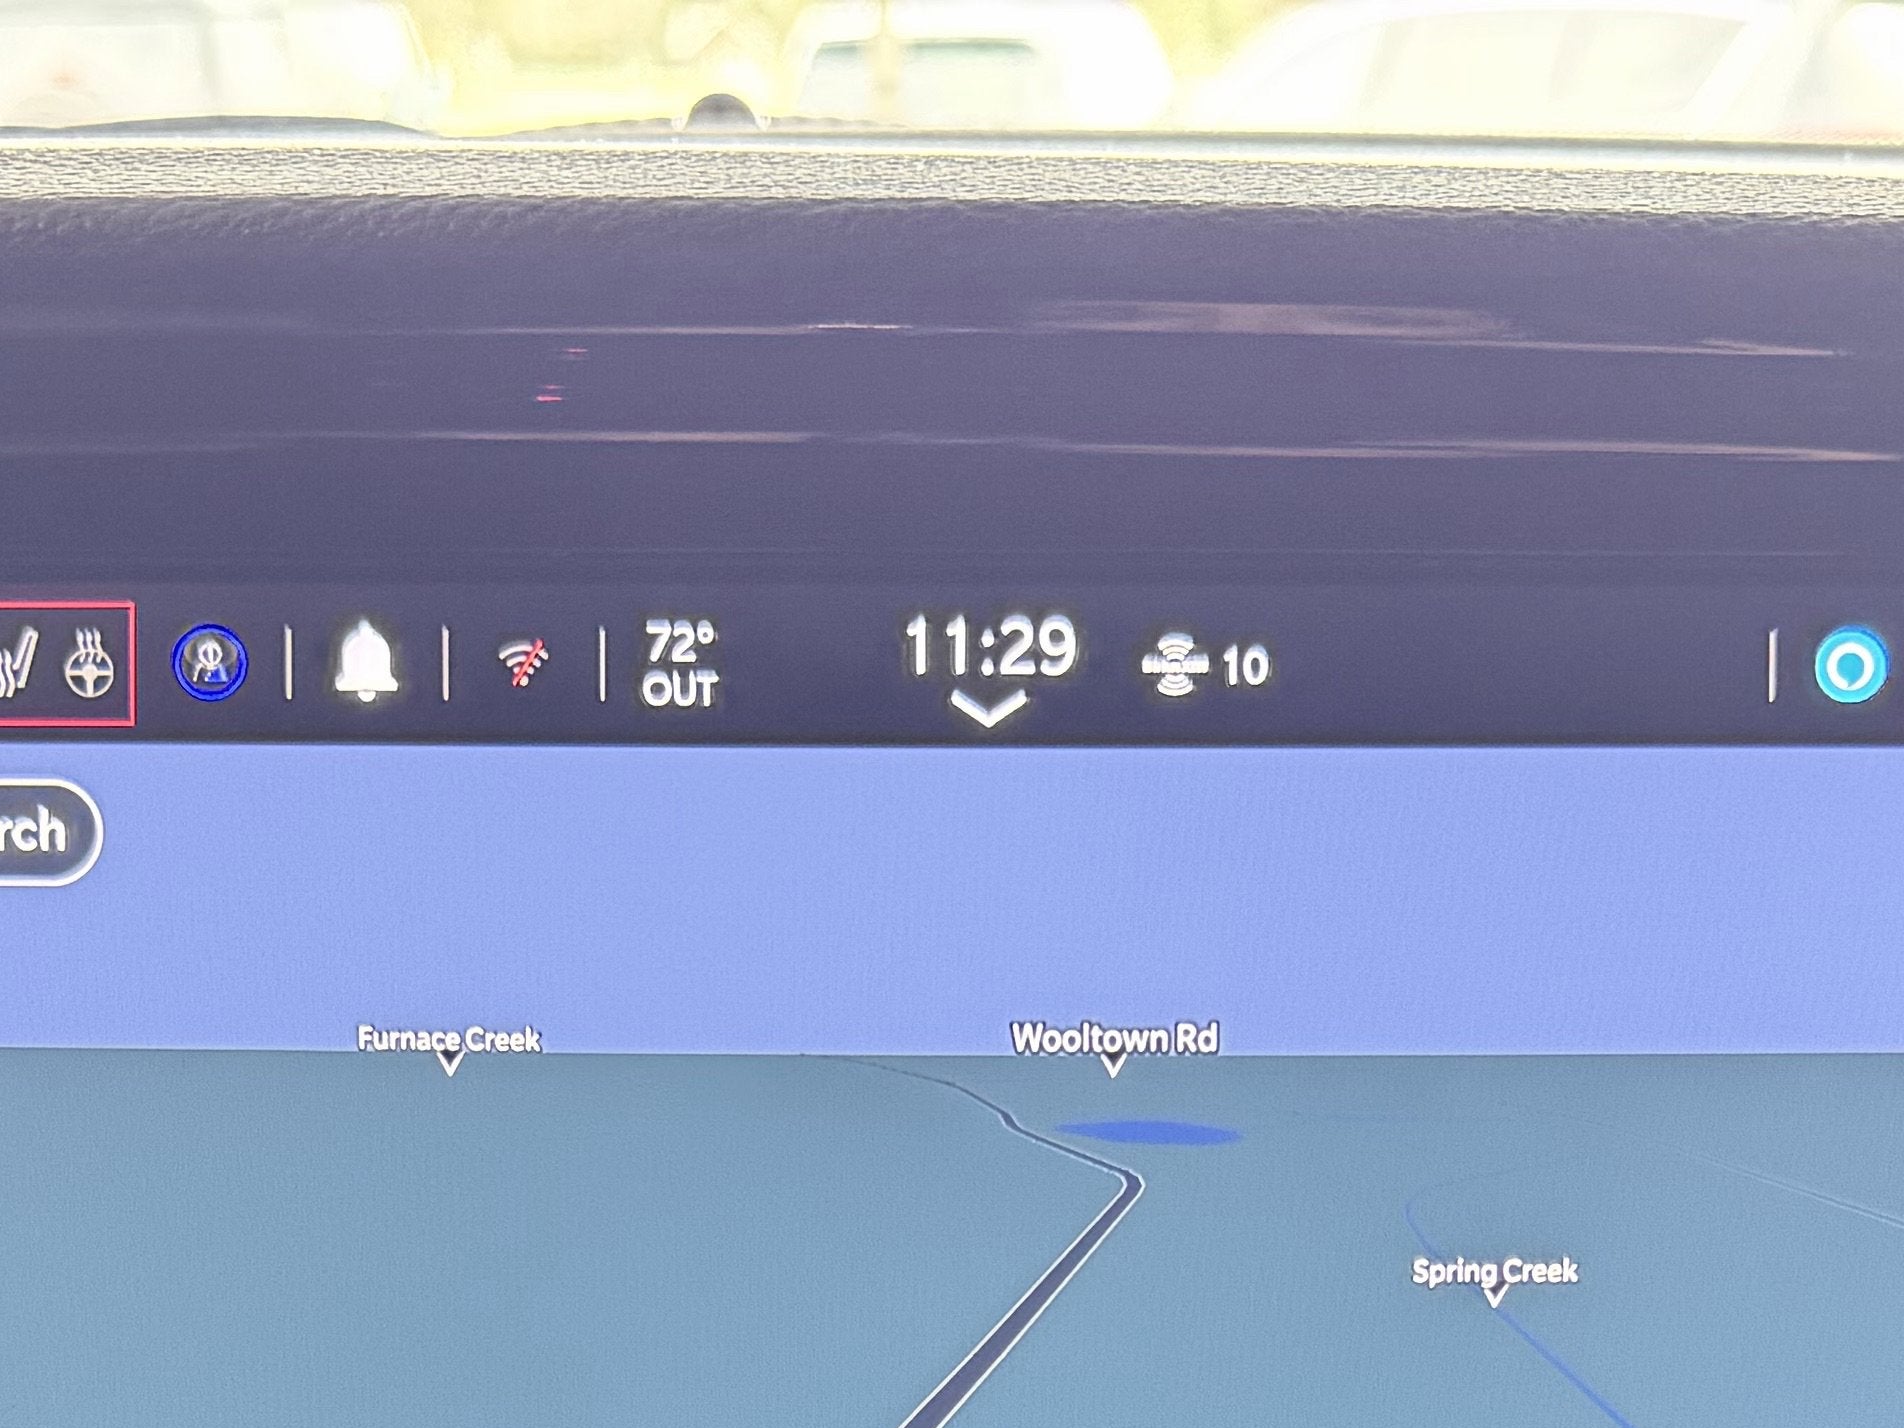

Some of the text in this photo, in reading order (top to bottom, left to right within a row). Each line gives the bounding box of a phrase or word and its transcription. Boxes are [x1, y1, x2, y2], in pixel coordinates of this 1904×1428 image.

[902, 613, 1079, 679] 11:29
[1222, 644, 1271, 687] 10
[640, 670, 722, 709] OUT
[355, 1023, 542, 1055] Furnace Creek
[1010, 1022, 1220, 1056] Wooltown Rd
[1411, 1256, 1580, 1291] Spring Creek
